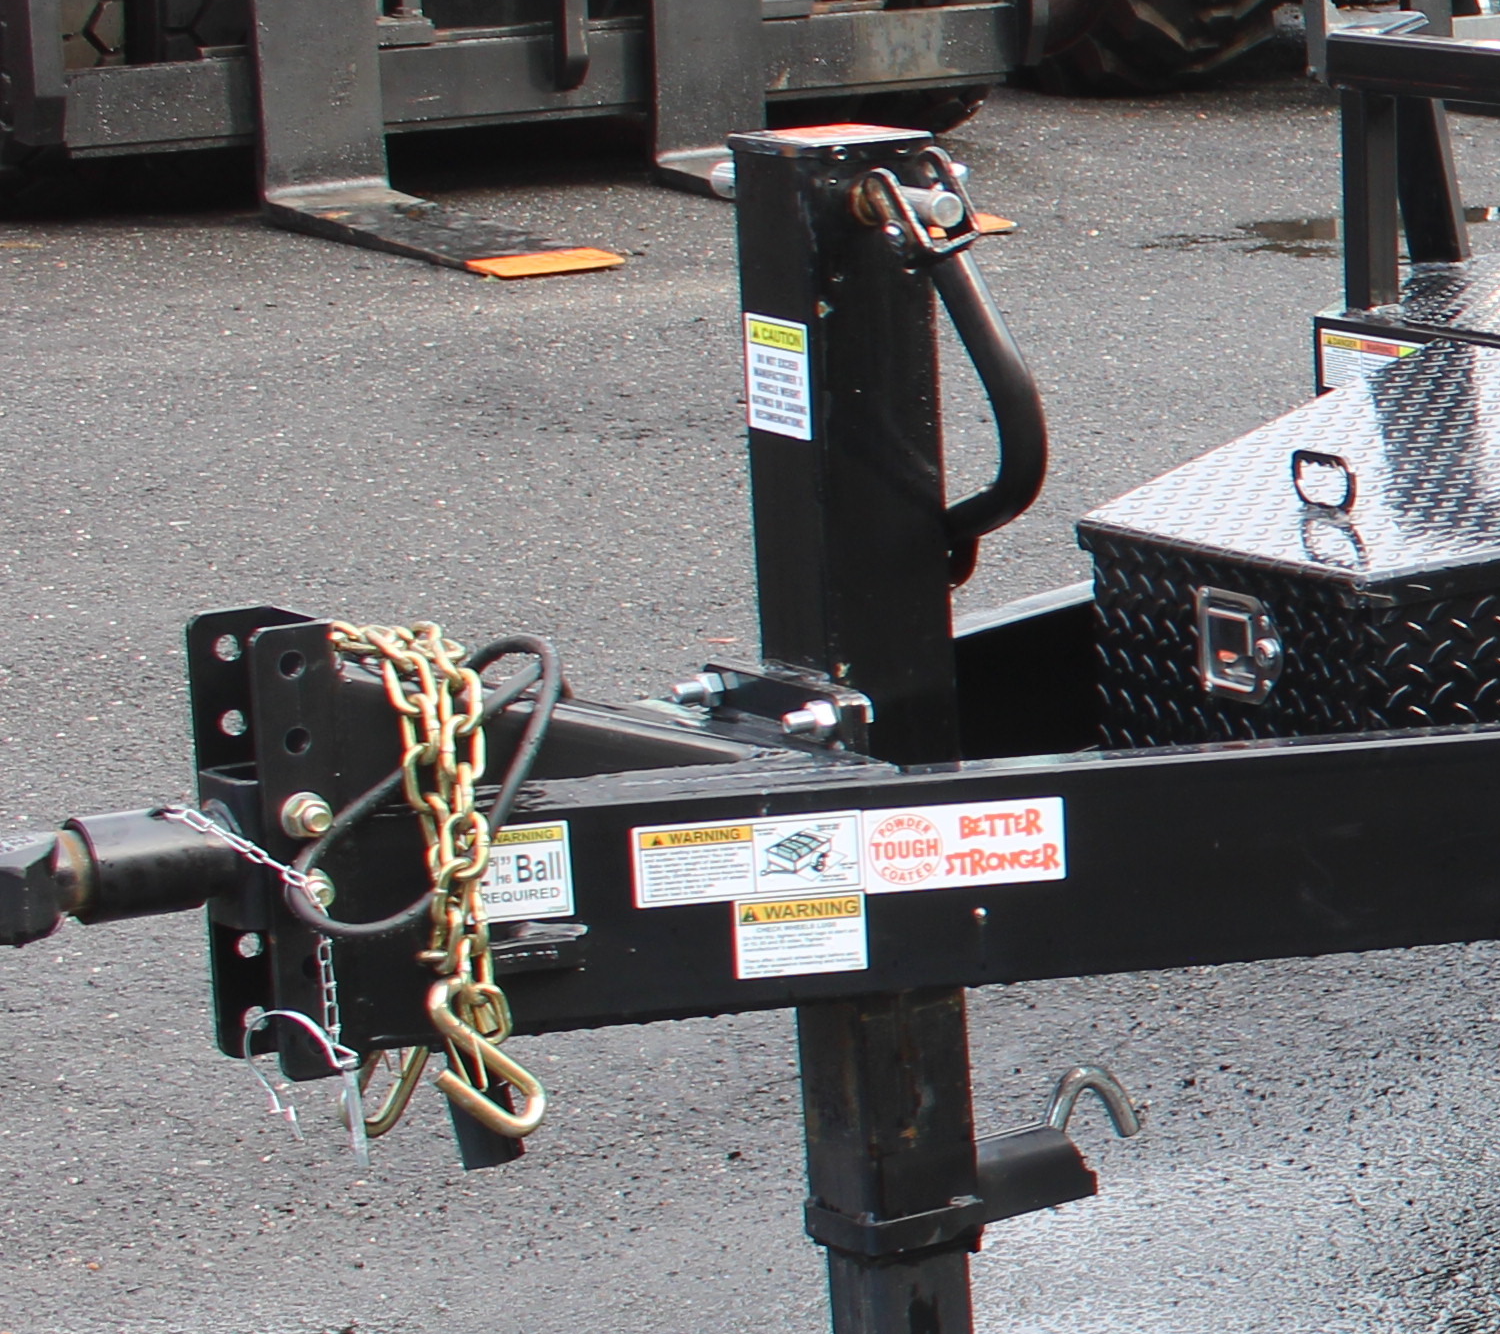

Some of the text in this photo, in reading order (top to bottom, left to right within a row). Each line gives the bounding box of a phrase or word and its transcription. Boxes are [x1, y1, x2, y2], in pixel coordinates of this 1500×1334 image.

[761, 327, 802, 347] CAUTION
[878, 817, 931, 838] POWDER
[959, 808, 1044, 839] BETTER
[668, 828, 741, 845] WARNING
[871, 838, 939, 862] TOUGH
[945, 843, 1061, 877] STRONGER
[515, 850, 562, 883] Ball
[881, 862, 932, 882] COATED
[482, 887, 561, 904] REQUIRED
[764, 900, 858, 920] WARNING
